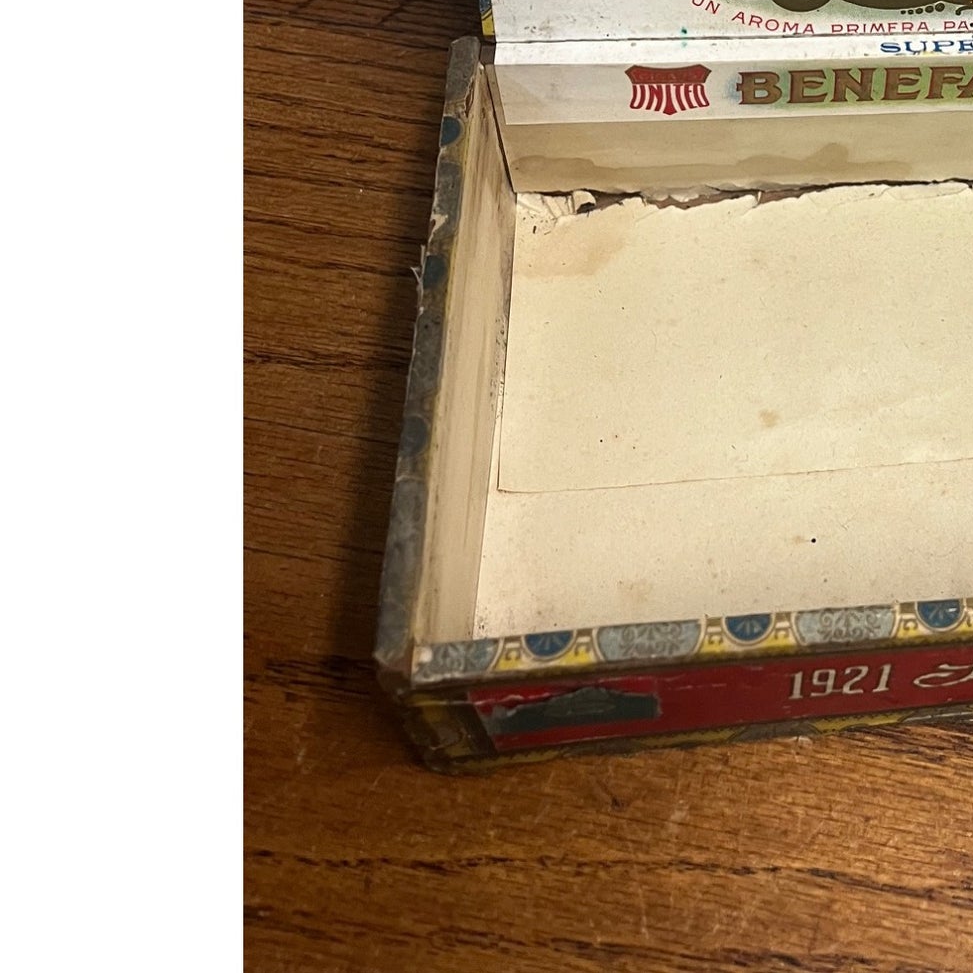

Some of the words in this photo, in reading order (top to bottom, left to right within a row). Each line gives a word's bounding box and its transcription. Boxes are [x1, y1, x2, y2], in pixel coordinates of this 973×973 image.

[731, 11, 815, 36] AROMA
[831, 20, 929, 35] PRIMERA
[629, 82, 710, 116] UNITED
[788, 663, 892, 701] 1921
